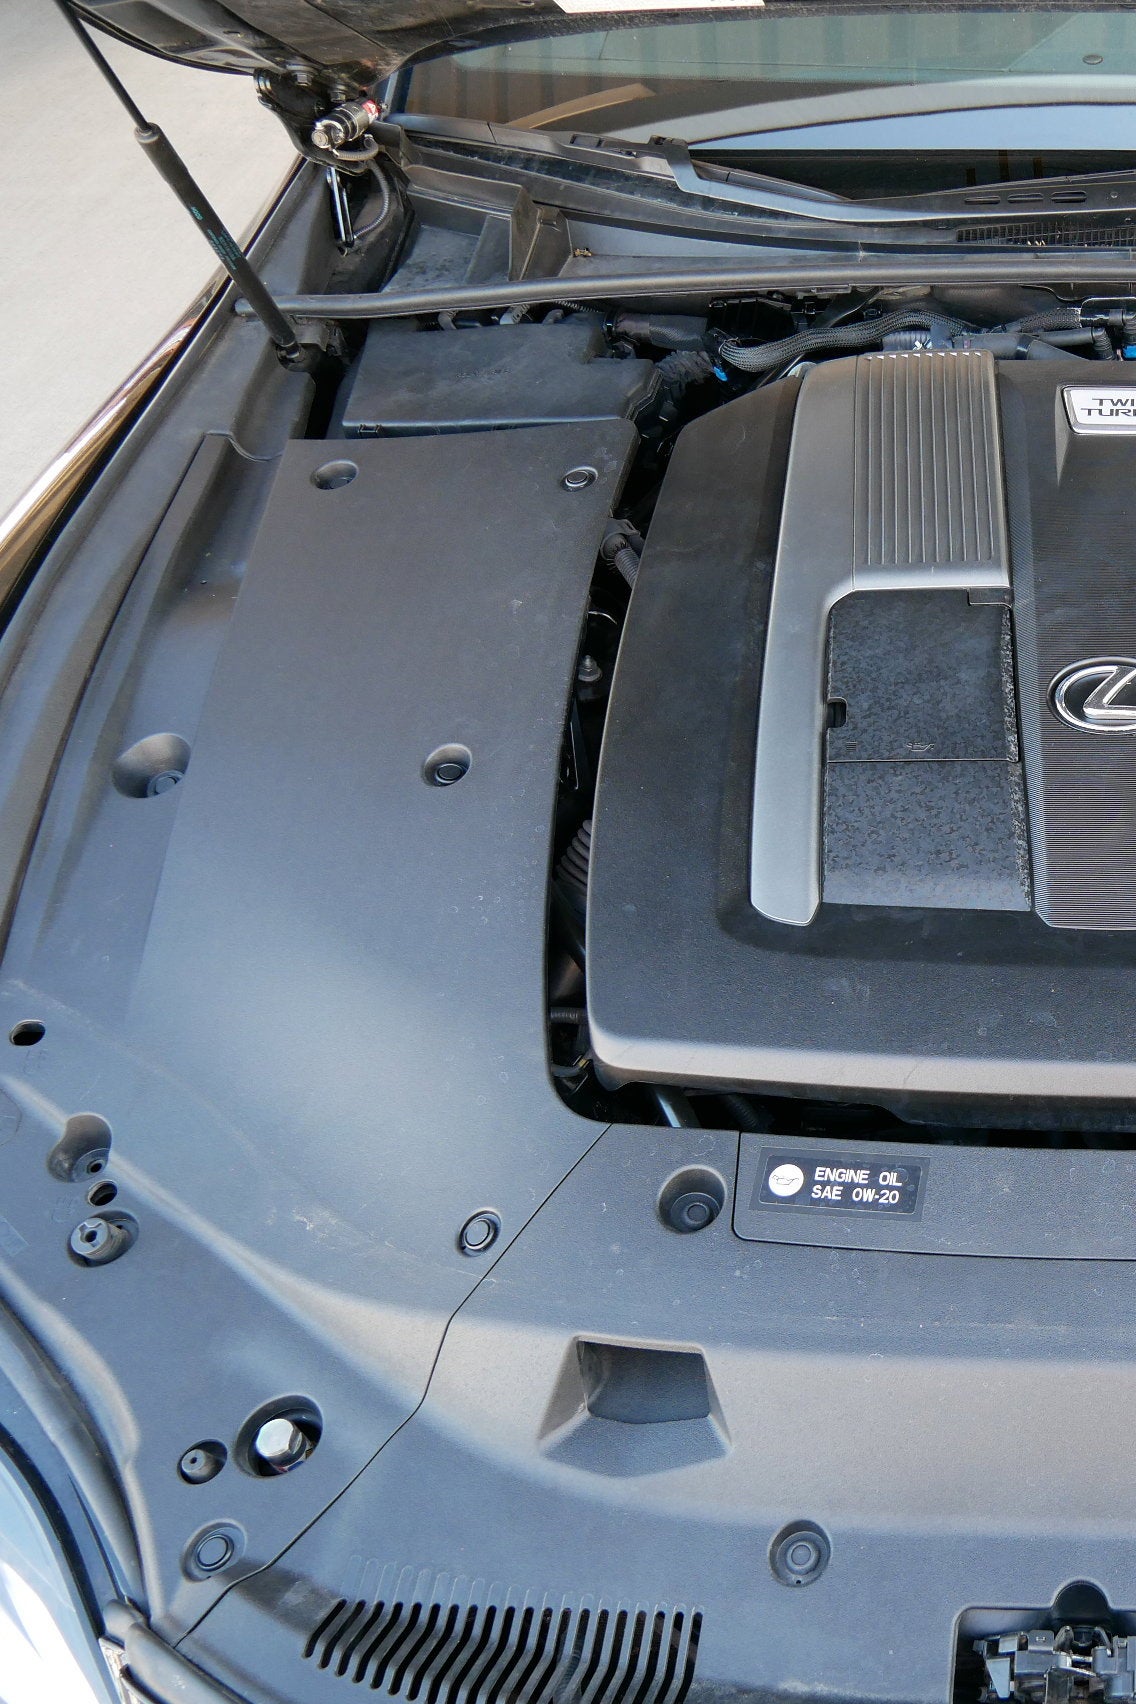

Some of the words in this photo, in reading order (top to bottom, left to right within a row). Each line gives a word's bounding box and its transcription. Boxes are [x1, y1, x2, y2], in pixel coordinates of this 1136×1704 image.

[814, 1167, 870, 1184] ENGINE
[878, 1171, 903, 1187] OIL
[811, 1184, 843, 1200] SAE
[852, 1187, 899, 1204] 0W-20
